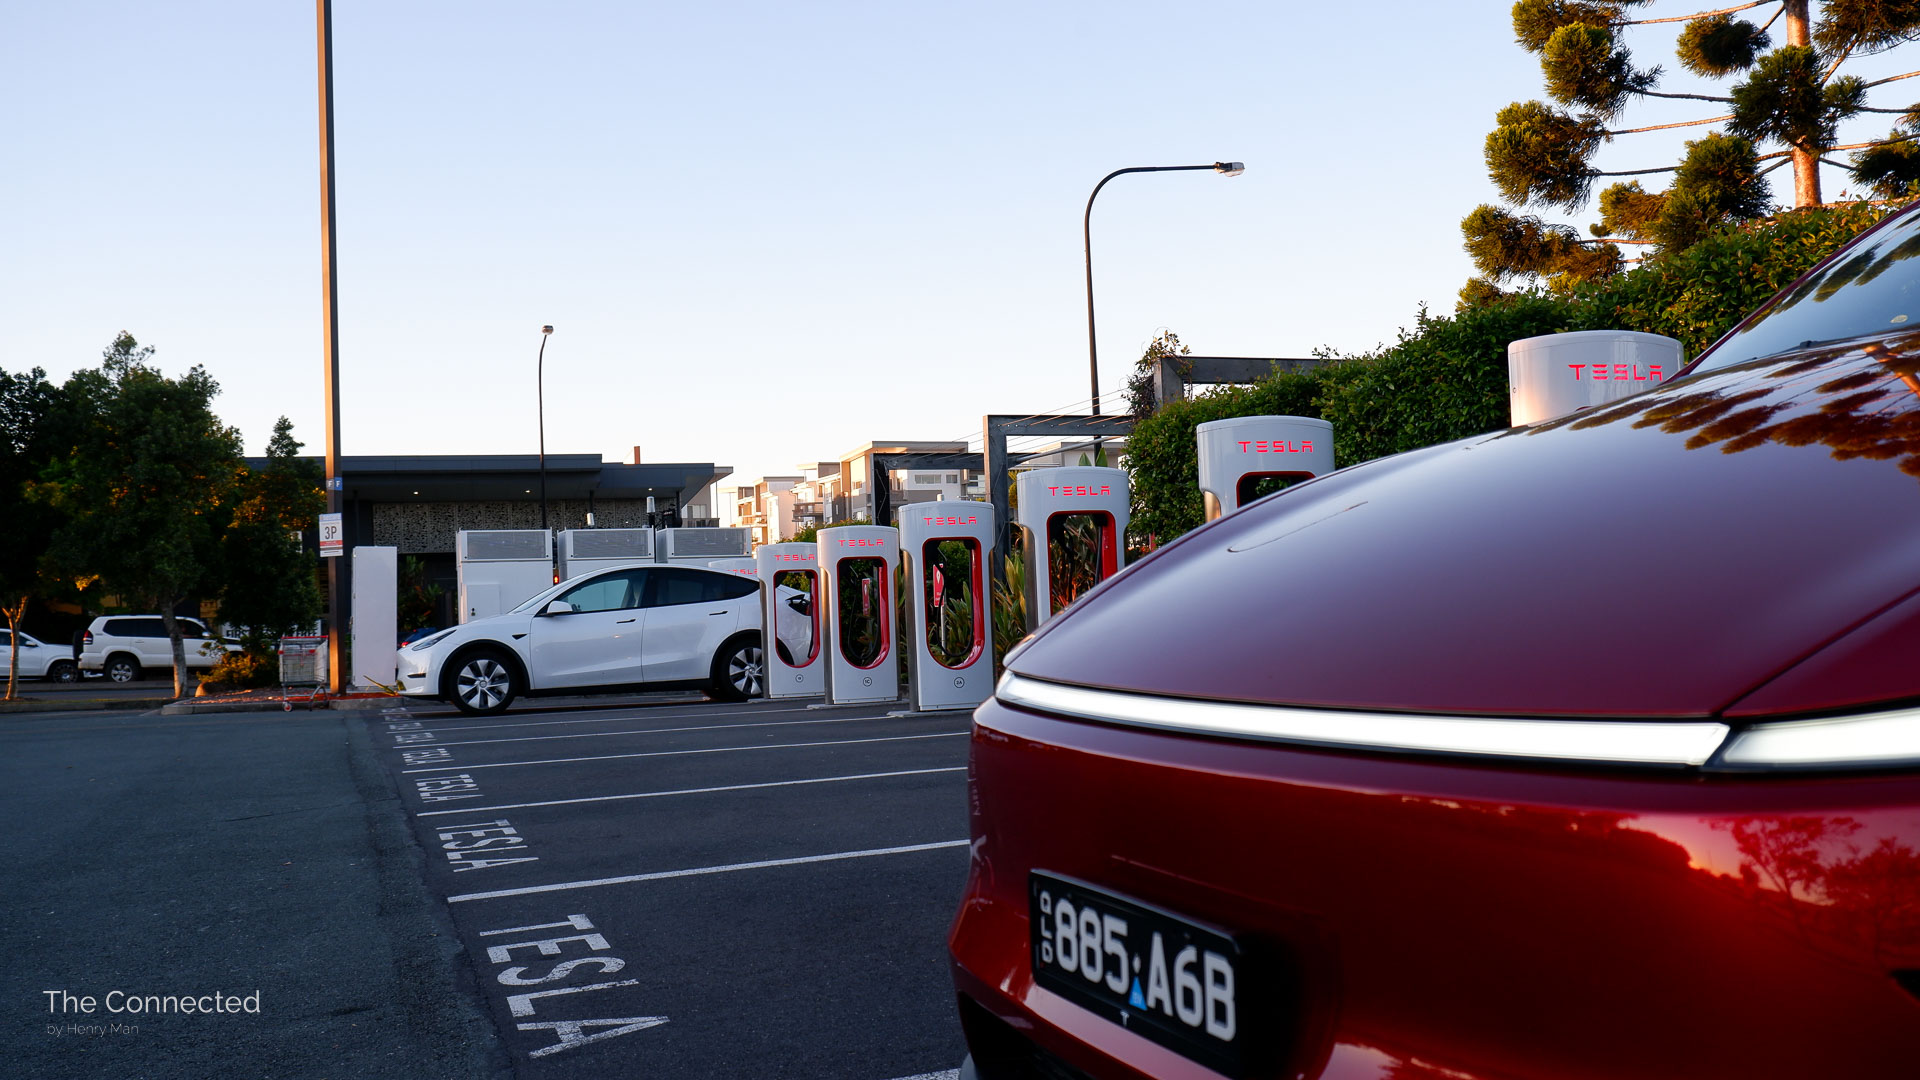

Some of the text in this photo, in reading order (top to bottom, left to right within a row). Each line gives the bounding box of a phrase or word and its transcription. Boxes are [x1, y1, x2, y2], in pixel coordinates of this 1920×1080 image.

[1568, 363, 1663, 382] TESLA
[1238, 440, 1313, 454] TESLA
[1048, 485, 1111, 497] TESLA
[923, 516, 977, 526] TESLA
[325, 526, 337, 540] 3P
[838, 538, 884, 547] TESLA
[774, 553, 816, 562] TESLA
[414, 774, 485, 803] TESLA
[436, 818, 539, 873] TESLA
[1040, 890, 1054, 964] QLD
[1055, 898, 1236, 1042] 885 A6B
[479, 914, 671, 1059] TESLA
